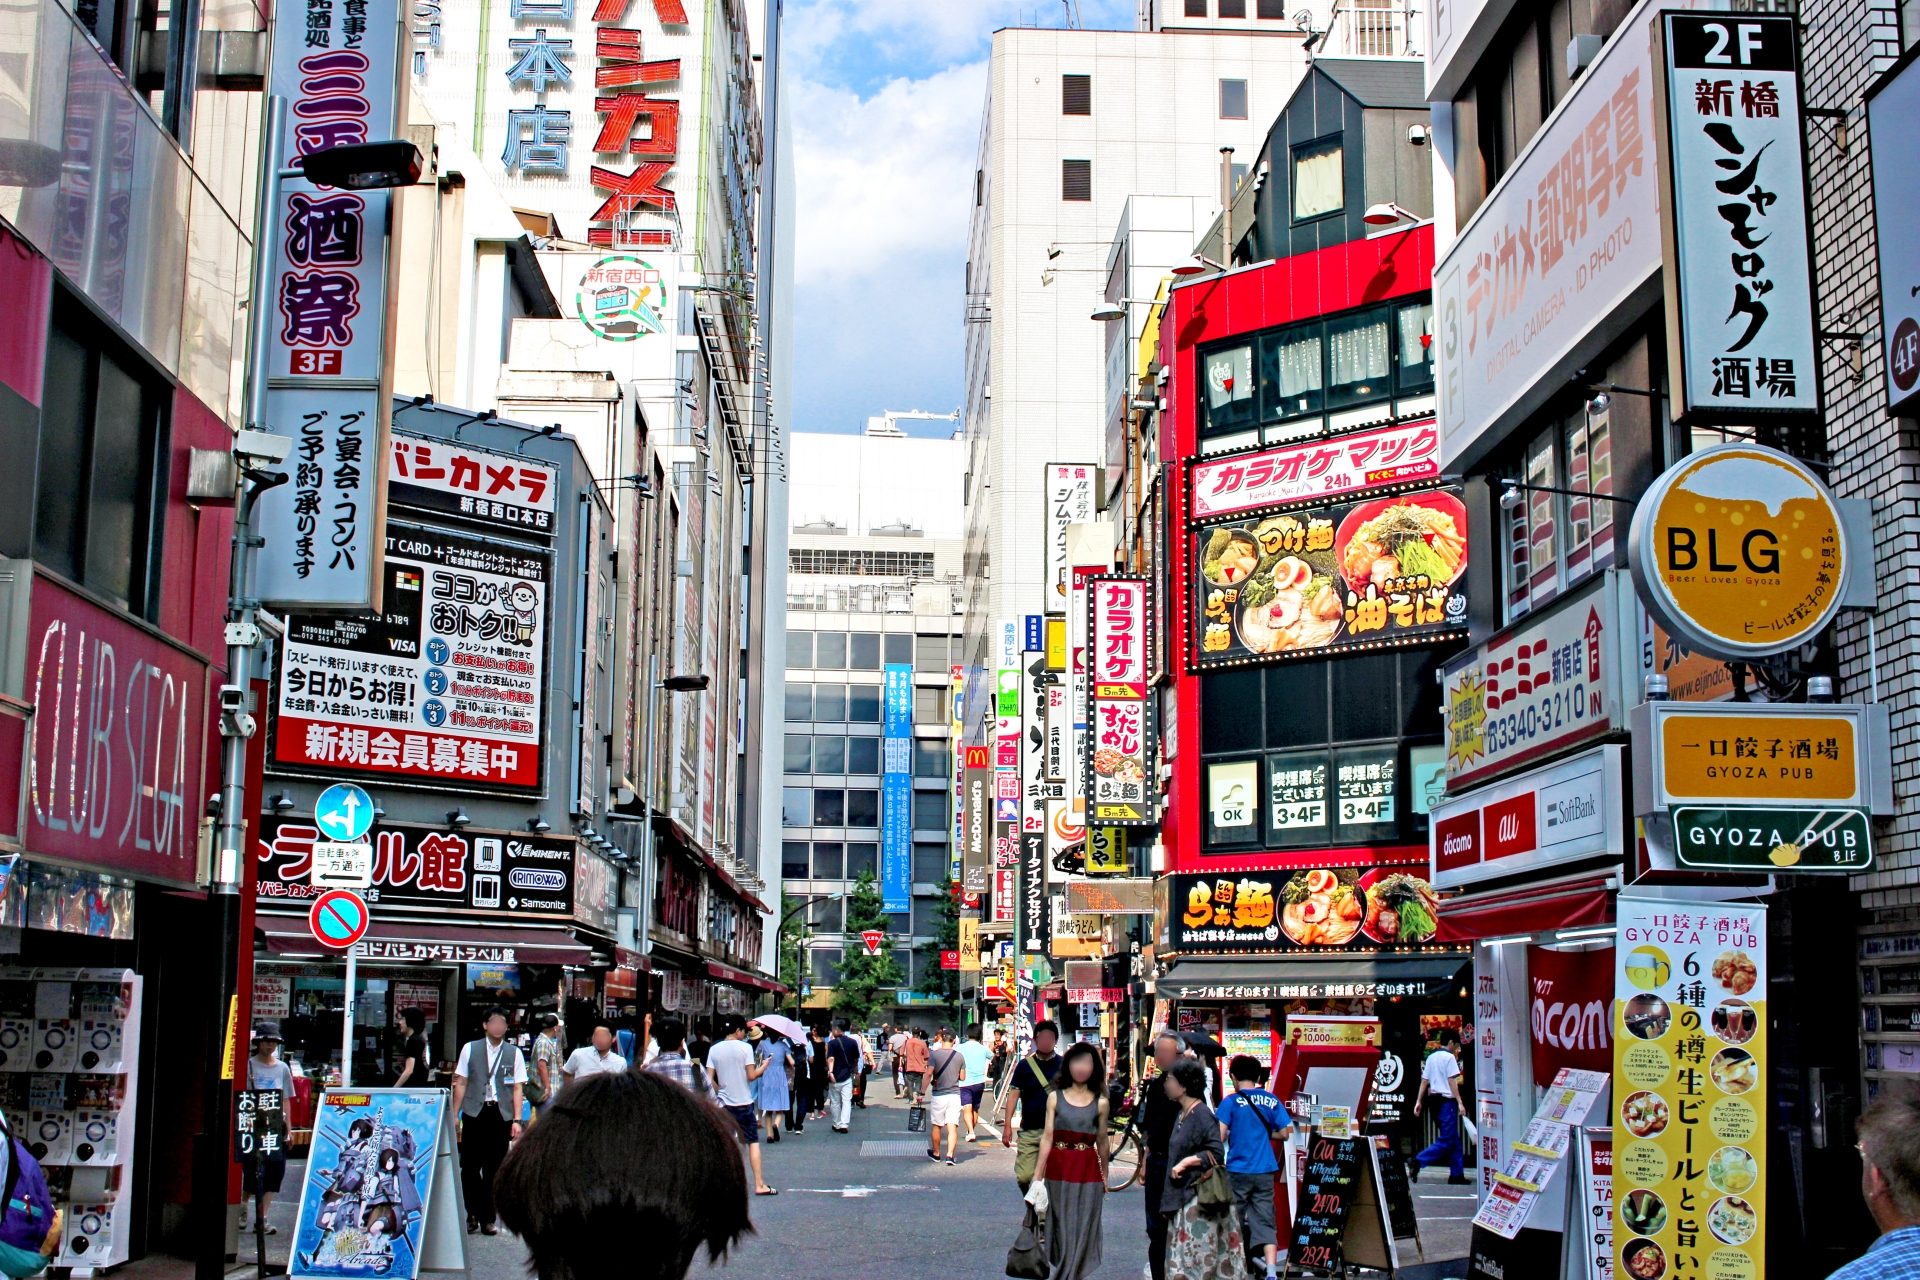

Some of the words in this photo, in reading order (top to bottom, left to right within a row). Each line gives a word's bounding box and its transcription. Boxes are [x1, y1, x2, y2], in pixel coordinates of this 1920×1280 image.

[1702, 23, 1763, 65] 2F
[1694, 79, 1780, 119] 新橋
[588, 0, 689, 245] シカメ
[1466, 65, 1644, 359] デジカメ・証明写真
[1702, 122, 1778, 353] シャモロック
[586, 268, 660, 284] 新宿西口
[1487, 332, 1522, 384] DIGITAL
[1523, 286, 1567, 348] CAMERA
[1575, 266, 1588, 295] ID
[1590, 216, 1634, 272] PHOTO
[298, 352, 336, 373] 3F
[1894, 330, 1918, 376] 4F
[1711, 357, 1797, 399] 酒場
[1211, 447, 1343, 495] カラオケ
[1347, 427, 1437, 469] マック
[1057, 467, 1087, 479] 警備
[1324, 474, 1352, 490] 24h
[292, 410, 329, 580] ご予約承ります
[329, 410, 366, 571] ご宴会・コンパ
[1075, 481, 1090, 519] 株式会社
[460, 496, 550, 528] 新宿西口本店
[1259, 517, 1337, 554] つけ麺
[398, 538, 432, 557] CARD
[446, 545, 542, 570] ゴールドポイントカード・プラス
[1667, 527, 1781, 574] BLG
[431, 570, 498, 606] ココが
[1668, 574, 1697, 584] Beer
[1703, 575, 1739, 585] Loves
[1745, 576, 1782, 587] Gyoza
[386, 613, 410, 626] 6789
[1345, 583, 1449, 636] 油そば
[346, 625, 368, 634] 00/00
[430, 601, 519, 643] おトク!!
[1106, 585, 1137, 678] カラオケ
[388, 637, 417, 653] VISA
[1004, 622, 1016, 667] 桑原ビル
[1588, 619, 1599, 673] 2F
[1643, 641, 1653, 669] 5
[433, 650, 441, 662] 1
[452, 652, 535, 675] お支払いがお得!
[1552, 638, 1582, 687] 新宿店
[286, 667, 416, 708] 今日からお得!
[431, 680, 439, 692] 2
[1050, 690, 1063, 699] 3F
[1103, 686, 1129, 697] 5m先
[887, 671, 897, 736] 営業いたします。
[898, 671, 908, 723] 今月も休まず
[1050, 698, 1063, 707] 2F
[1589, 690, 1602, 718] IN
[429, 711, 438, 723] 3
[1498, 683, 1585, 750] 3340-3210
[32, 619, 117, 839] CLUB
[119, 658, 188, 859] SEGA
[1680, 737, 1840, 761] 一口餃子酒場
[304, 723, 519, 780] 新規会員募集中
[1003, 756, 1015, 764] 3F
[1272, 769, 1312, 788] 喫煙席
[1313, 776, 1325, 784] OK
[1338, 763, 1381, 782] 喫煙席
[1381, 771, 1393, 779] OK
[1706, 765, 1768, 779] GYOZA
[1780, 767, 1814, 779] PUB
[1027, 785, 1064, 797] 三代目
[1272, 785, 1326, 804] ございます
[1338, 781, 1394, 798] ございます
[971, 780, 983, 853] McDonald's
[1103, 807, 1129, 818] 5m先
[1222, 808, 1243, 821] OK
[1276, 804, 1322, 826] 3・4F
[1343, 800, 1390, 821] 3・4F
[1558, 793, 1596, 825] SoftBank
[1025, 816, 1043, 830] 2F
[1498, 812, 1520, 843] au
[1443, 833, 1472, 856] docomo
[1690, 826, 1784, 848] GYOZA
[1803, 828, 1857, 848] PUB
[257, 823, 469, 893] ラル館
[521, 844, 571, 861] EMINENT
[316, 860, 366, 872] 一方通行
[516, 871, 562, 887] RIMOWA
[1026, 836, 1043, 950] ケータイアクセサリー館
[520, 898, 566, 910] Samsonite
[1056, 919, 1096, 935] 讃岐うどん
[1632, 913, 1751, 934] 一口餃子酒場
[1625, 927, 1701, 945] GYOZA
[1717, 932, 1758, 948] PUB
[355, 942, 516, 963] ヨドバシカメラトラベル館
[1068, 989, 1085, 1002] 両替
[1478, 975, 1495, 995] スマホ
[1536, 980, 1553, 996] NTT
[901, 992, 909, 1004] P
[1478, 1000, 1498, 1020] プリント
[1303, 1033, 1330, 1043] 10,000
[1571, 1072, 1603, 1091] SoftBank
[238, 1092, 256, 1155] お断り
[257, 1091, 281, 1157] 駐車
[1672, 951, 1708, 1280] 6種の樽生ビールと旨い
[1483, 1135, 1499, 1163] 証明
[1593, 1207, 1603, 1216] 6F
[1595, 1235, 1605, 1244] 4F
[337, 1252, 385, 1266] Arcade
[1481, 1256, 1505, 1280] SoftBank
[1597, 1258, 1607, 1266] 3F
